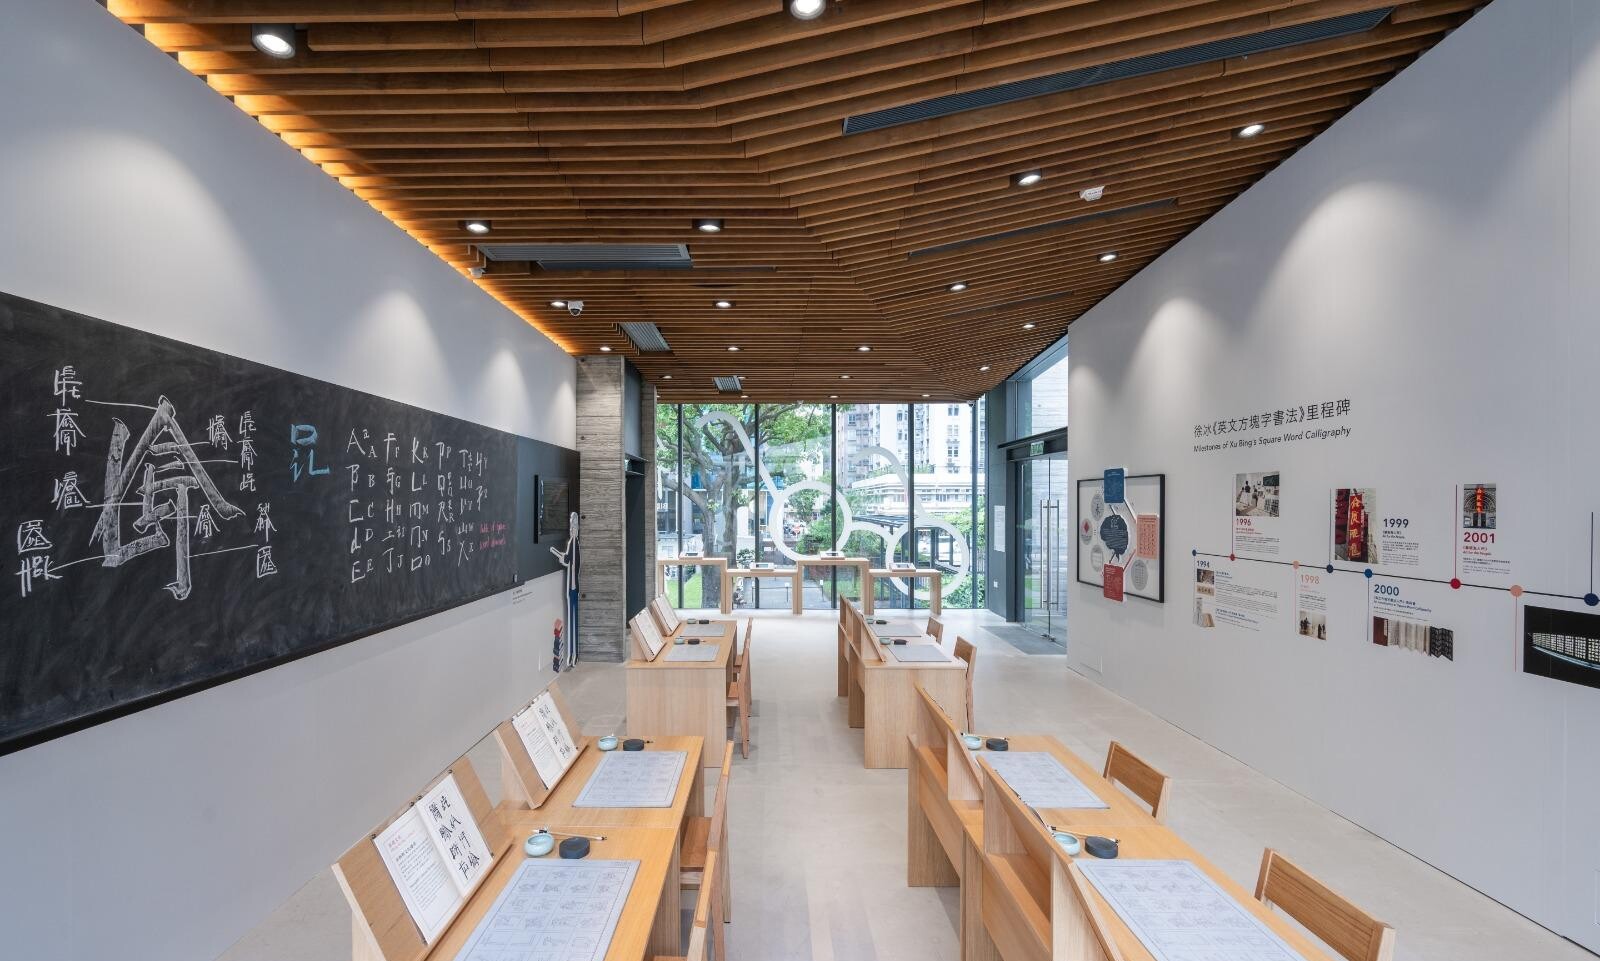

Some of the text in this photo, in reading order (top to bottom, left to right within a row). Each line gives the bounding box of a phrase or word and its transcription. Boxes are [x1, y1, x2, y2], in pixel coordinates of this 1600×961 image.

[1230, 440, 1238, 448] Xu
[1258, 436, 1282, 448] Square
[1284, 432, 1304, 442] Word
[1306, 426, 1352, 440] Calligraphy
[1236, 518, 1252, 526] 1996
[1384, 518, 1409, 528] 1999
[1464, 532, 1495, 544] 2001
[1301, 574, 1320, 584] 1998
[1374, 584, 1399, 596] 2000
